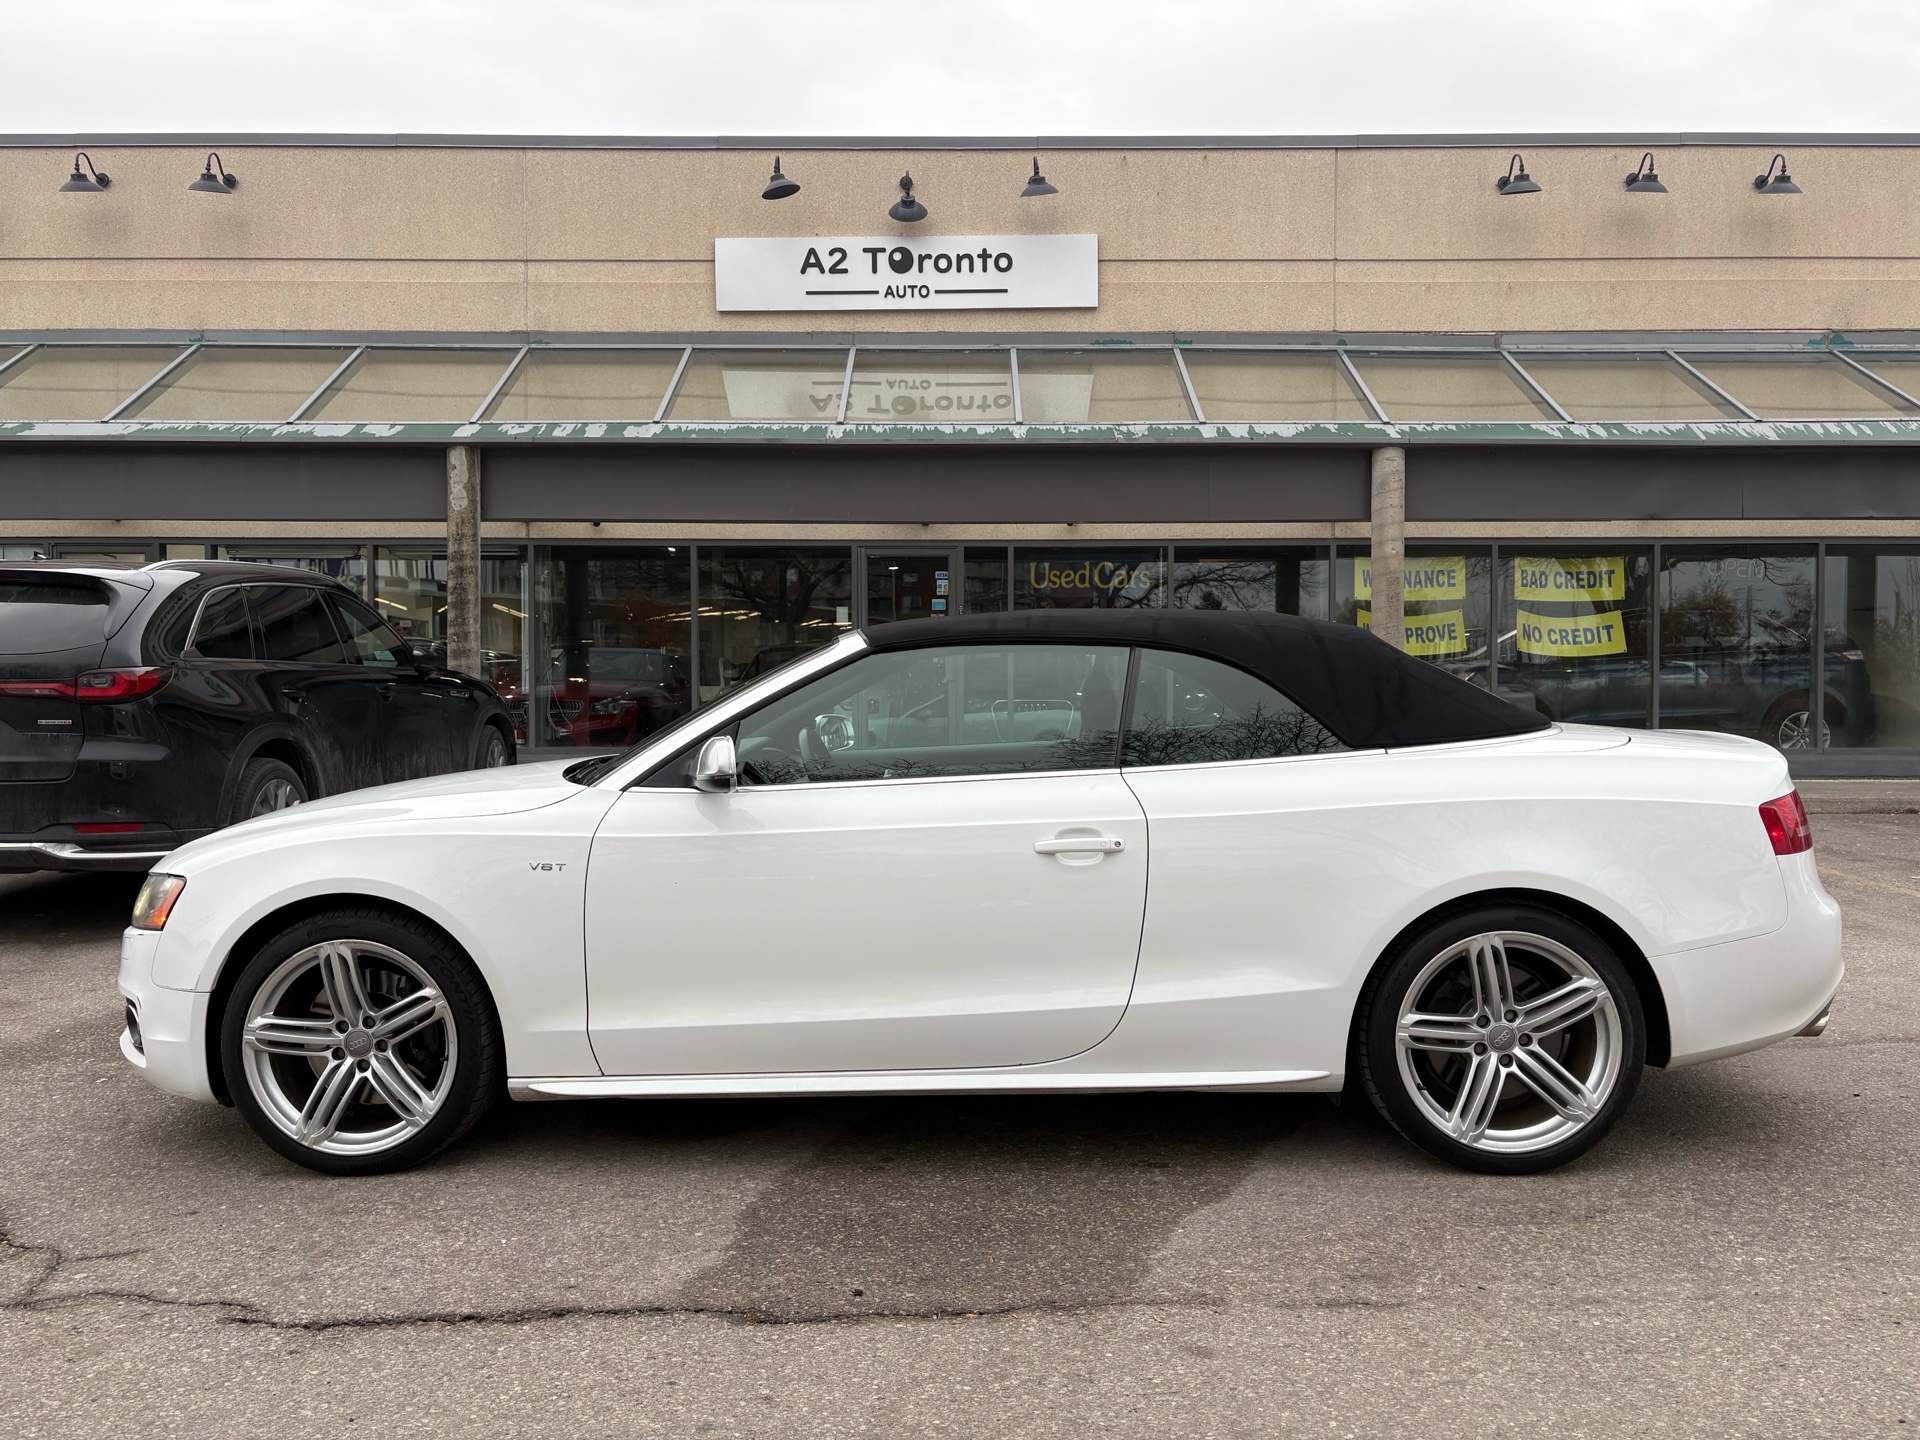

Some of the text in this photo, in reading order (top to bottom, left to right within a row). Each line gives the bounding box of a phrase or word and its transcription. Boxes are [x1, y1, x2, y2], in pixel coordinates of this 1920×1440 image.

[800, 247, 849, 275] A2
[884, 285, 930, 299] AUTO
[1029, 561, 1151, 590] Used Cars
[1362, 569, 1457, 589] W NANCE
[1521, 569, 1615, 590] BAD CREDIT
[1707, 559, 1764, 578] OPEN
[1404, 622, 1458, 645] PROVE
[1522, 622, 1614, 646] NO CREDIT
